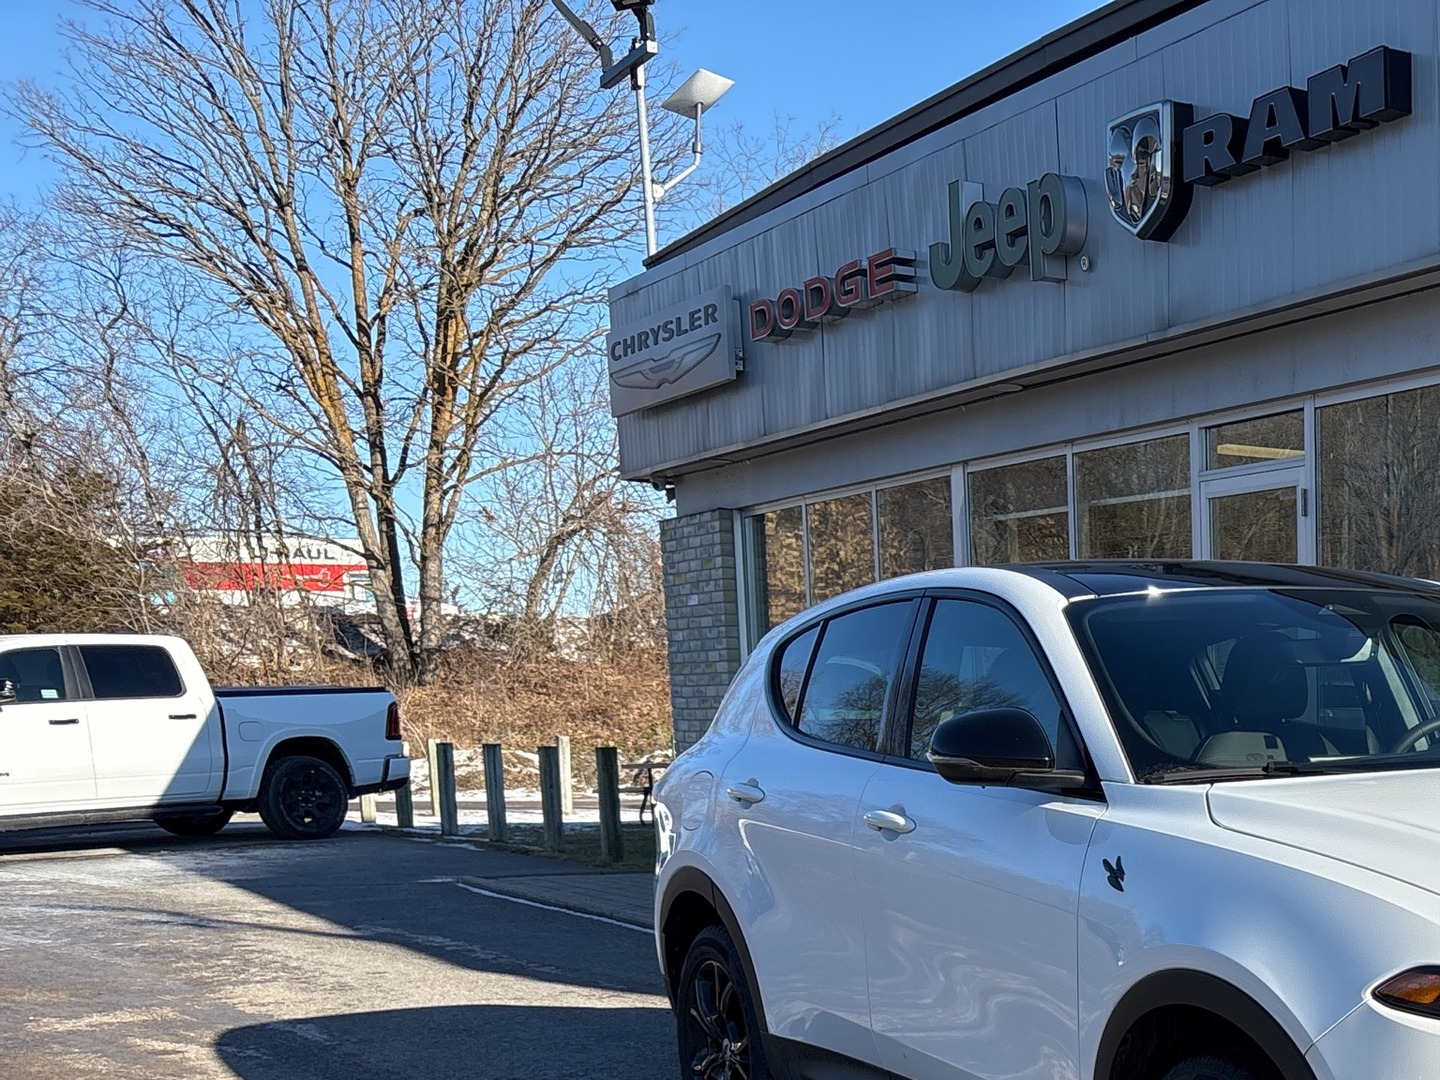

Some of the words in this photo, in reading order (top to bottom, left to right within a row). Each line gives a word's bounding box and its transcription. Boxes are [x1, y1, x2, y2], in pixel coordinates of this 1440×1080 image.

[1183, 46, 1386, 183] RAM
[928, 172, 1068, 291] Jeep
[610, 303, 718, 362] CHRYSLER
[749, 248, 897, 342] DODGE
